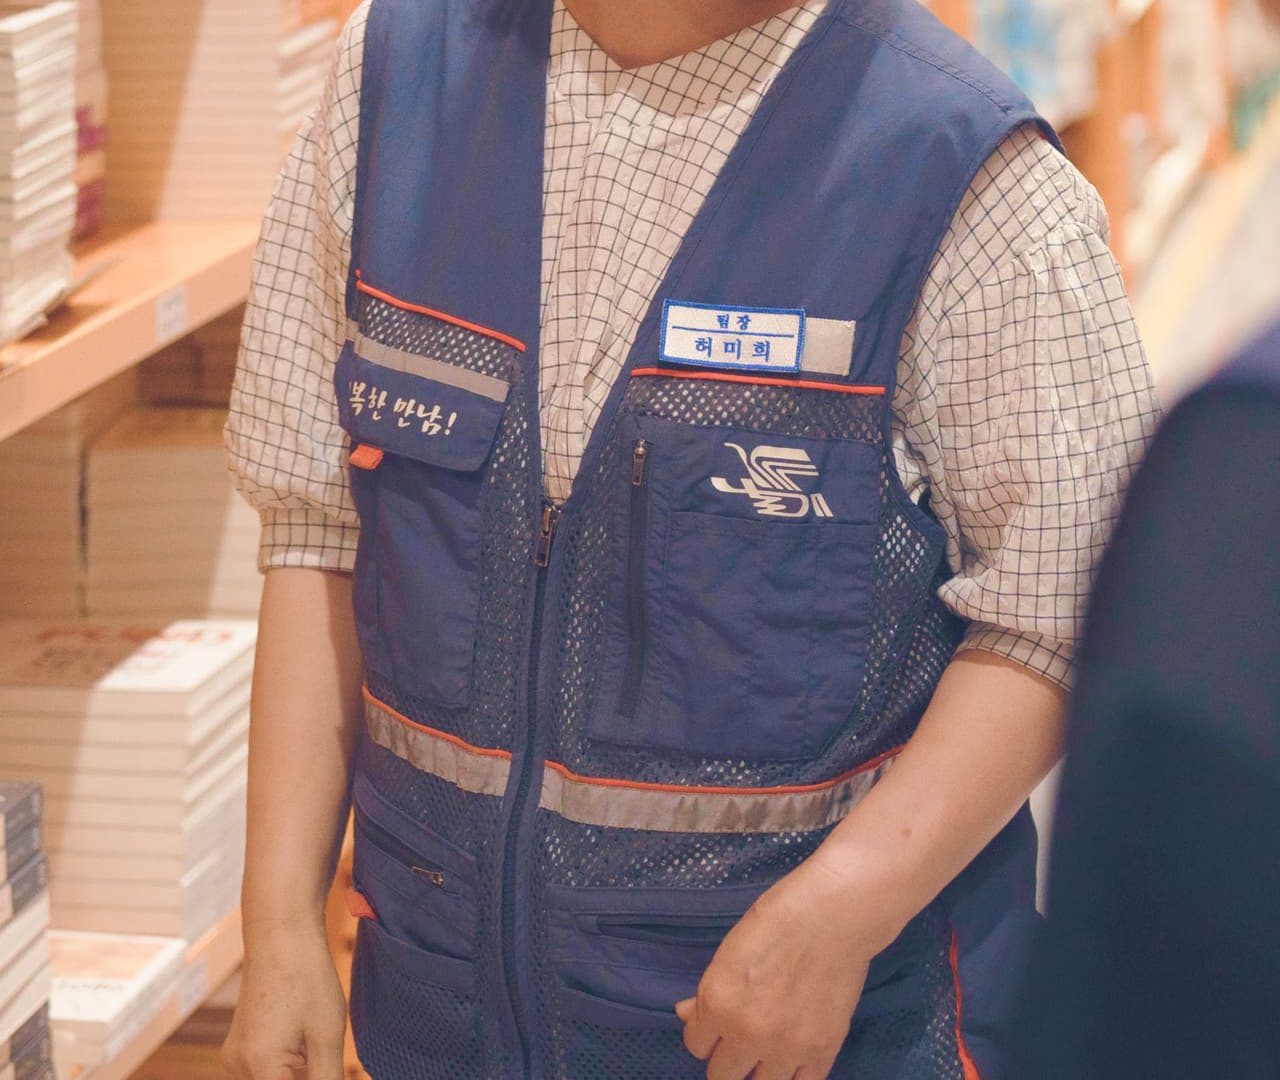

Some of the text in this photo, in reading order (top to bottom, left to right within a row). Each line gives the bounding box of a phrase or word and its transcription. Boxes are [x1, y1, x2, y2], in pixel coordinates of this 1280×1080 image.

[694, 337, 771, 362] 허미희
[348, 380, 457, 435] 복한 만남!
